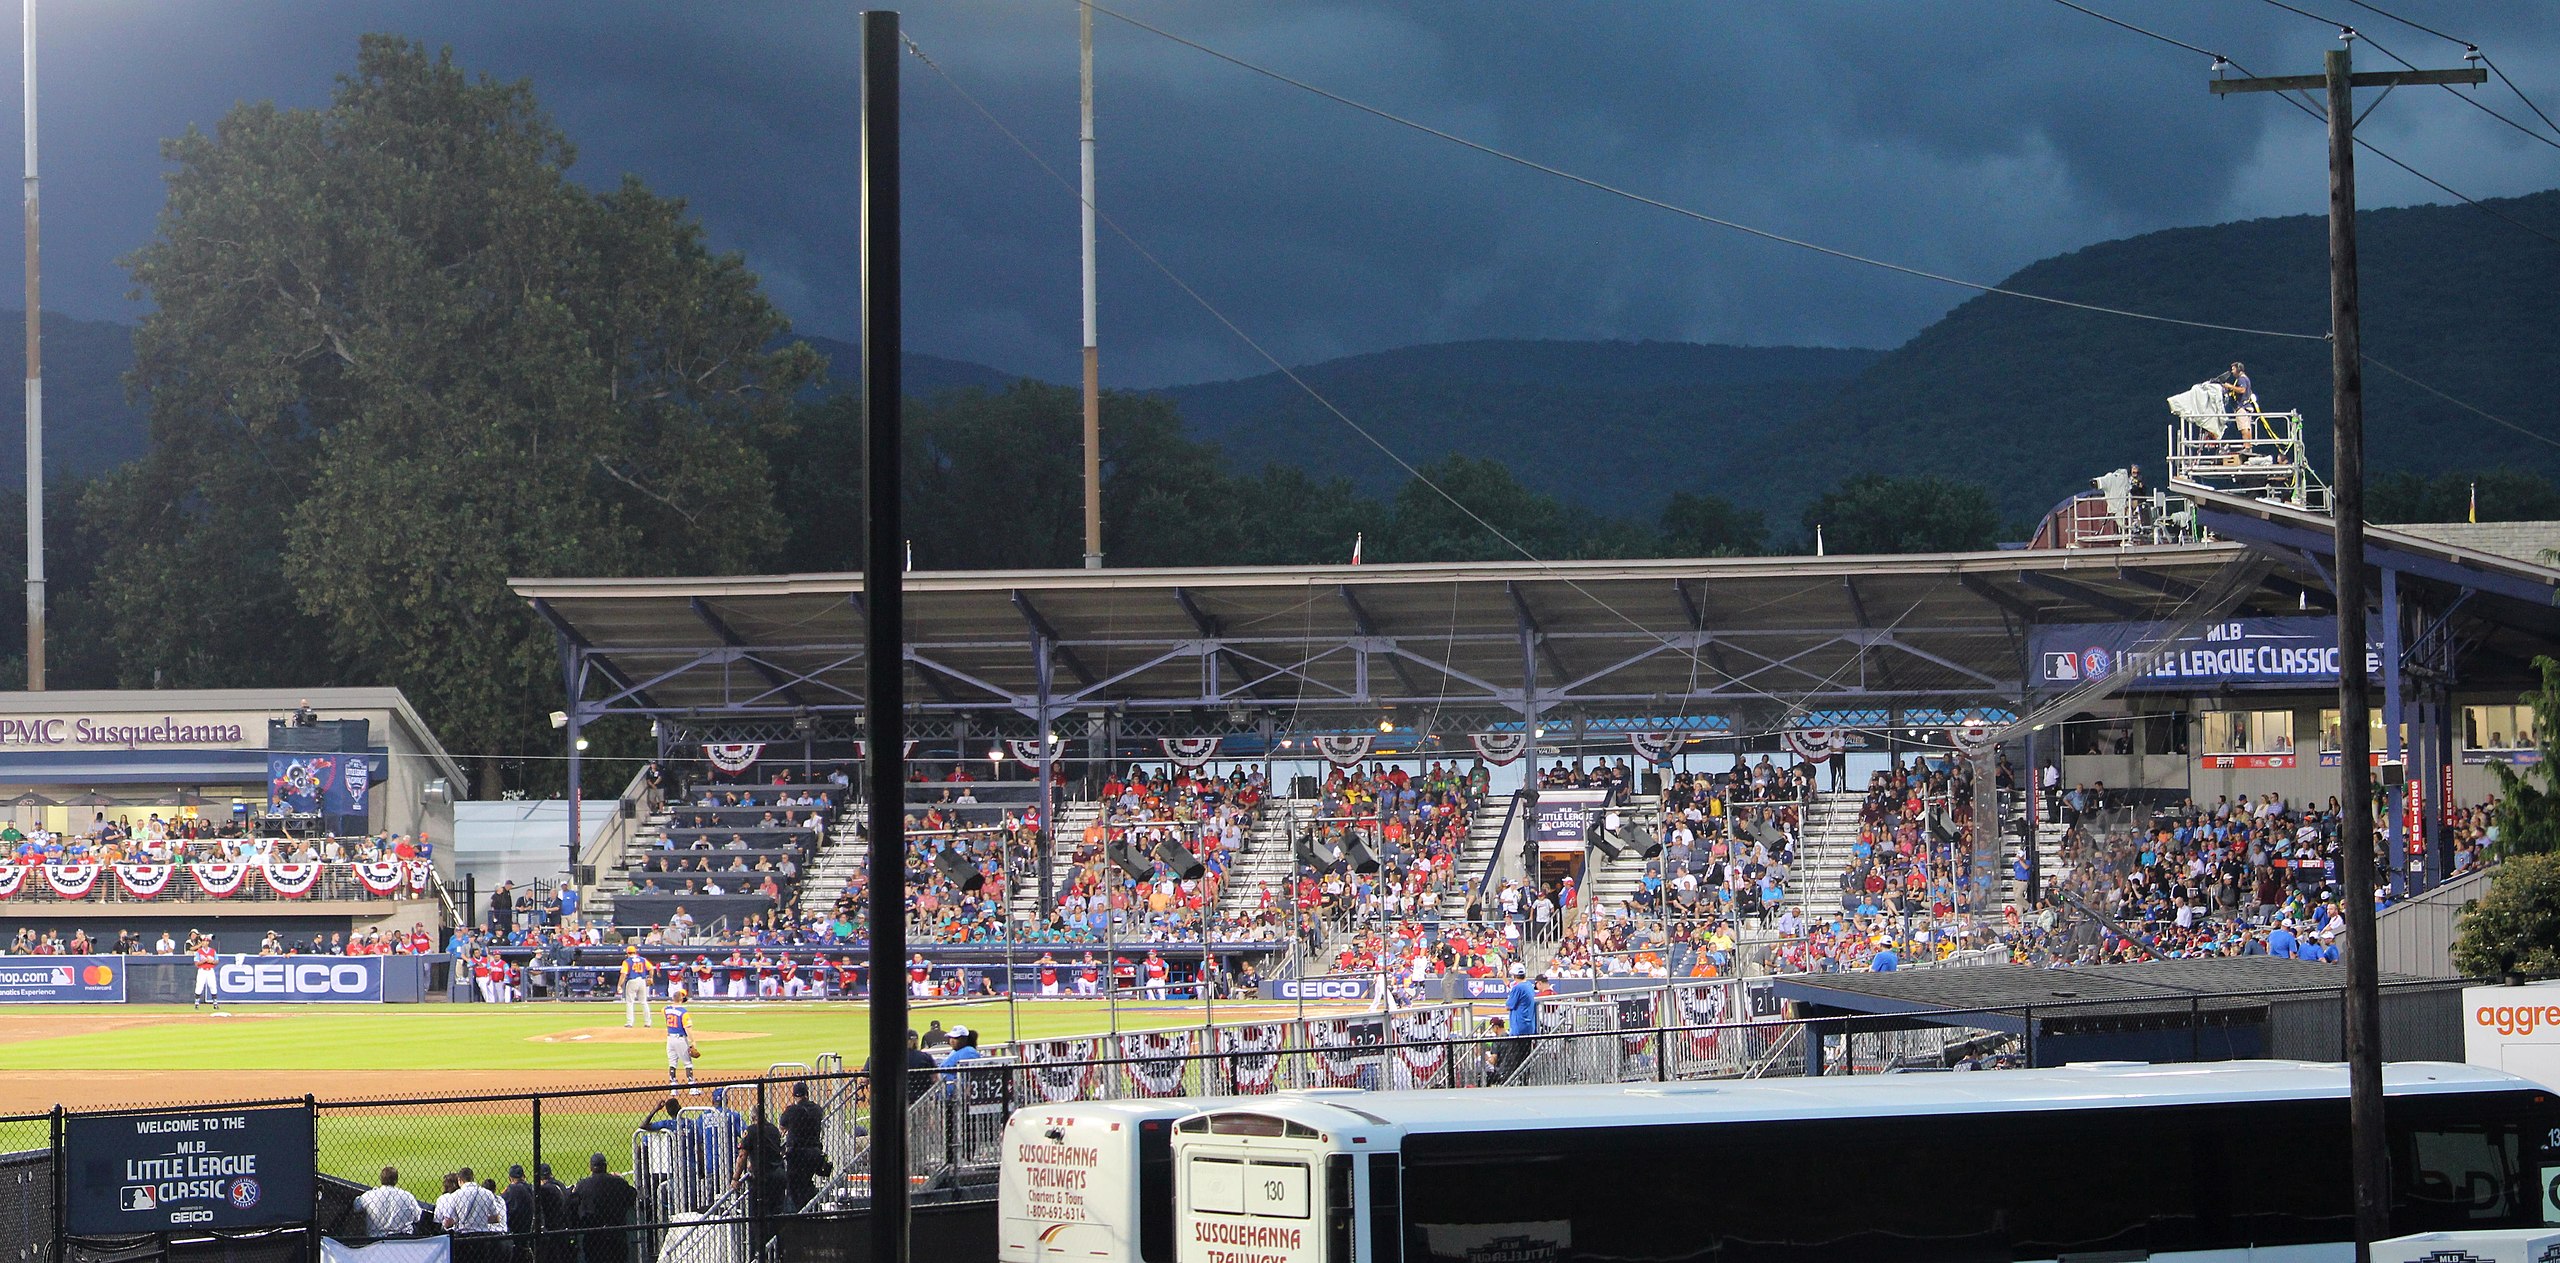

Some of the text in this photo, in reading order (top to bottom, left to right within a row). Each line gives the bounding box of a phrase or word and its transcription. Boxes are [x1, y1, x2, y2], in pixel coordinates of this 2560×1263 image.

[2206, 623, 2243, 642] MLB
[2115, 650, 2177, 677] LITTLE
[2180, 648, 2256, 676] LEAGUE
[2257, 645, 2340, 675] CLASSIC
[75, 716, 244, 750] Susquehanna
[2445, 765, 2453, 816] SECTION
[1552, 820, 1581, 829] CLASSIC
[2411, 781, 2421, 853] SECTION 7
[632, 962, 645, 974] 40
[219, 963, 368, 994] GEICO
[21, 988, 56, 997] Experience
[1282, 981, 1361, 998] GEICO
[1484, 984, 1506, 994] MLB
[1757, 996, 1776, 1013] 2 1
[666, 1014, 679, 1028] 21
[1625, 1010, 1631, 1023] 3
[1632, 1009, 1637, 1022] 2
[2476, 1005, 2560, 1036] aggre
[970, 1080, 979, 1099] 3
[136, 1116, 245, 1134] WELCOME TO THE
[177, 1140, 206, 1155] MLB
[1018, 1143, 1098, 1168] SUSQUEHANNA
[126, 1154, 256, 1181] LITTLE LEAGUE
[1026, 1167, 1087, 1190] TRAILWAYS
[158, 1179, 226, 1202] CLASSIC
[1028, 1189, 1084, 1205] Charters & Tours
[1264, 1180, 1285, 1201] 130
[170, 1210, 214, 1224] GEICO
[1026, 1204, 1086, 1220] 1-800-692-6314
[1195, 1222, 1301, 1251] SUSQUEHANNA
[2439, 1255, 2460, 1263] MLB
